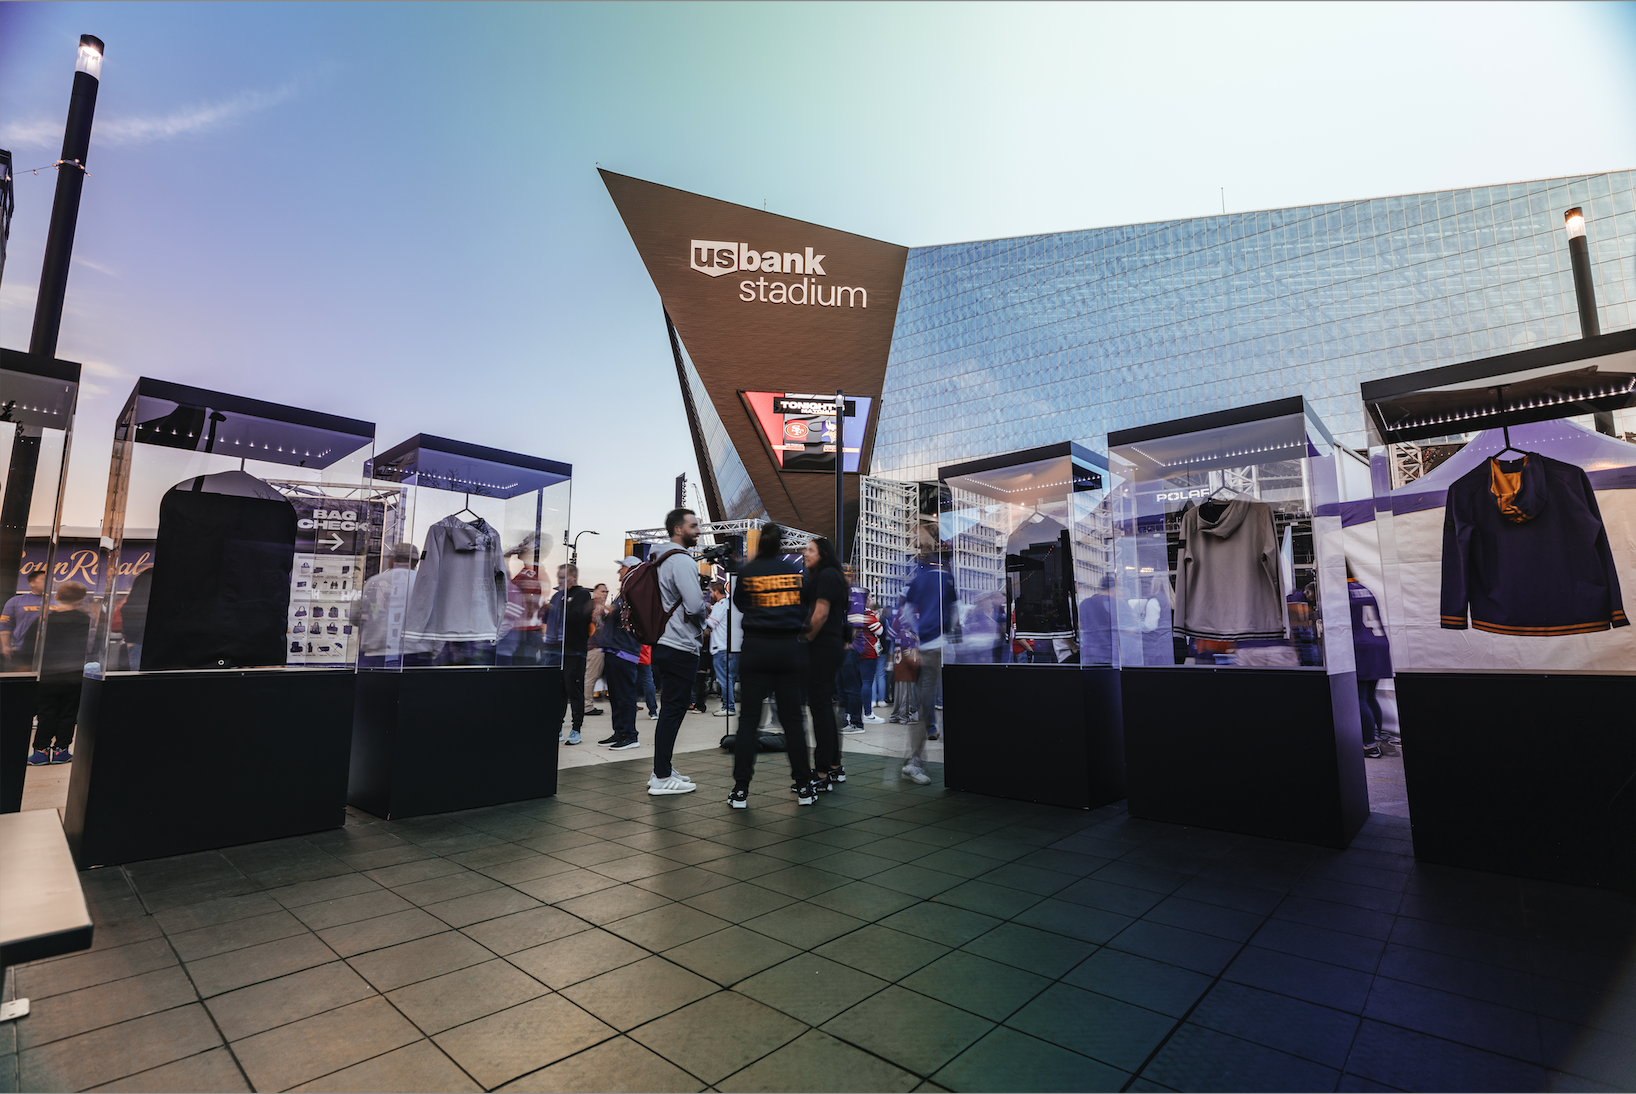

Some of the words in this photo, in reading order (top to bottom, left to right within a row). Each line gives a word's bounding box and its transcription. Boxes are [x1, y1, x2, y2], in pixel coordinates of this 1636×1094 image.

[739, 277, 867, 308] stadium
[780, 401, 845, 411] TONIGHT
[313, 509, 357, 521] BAG
